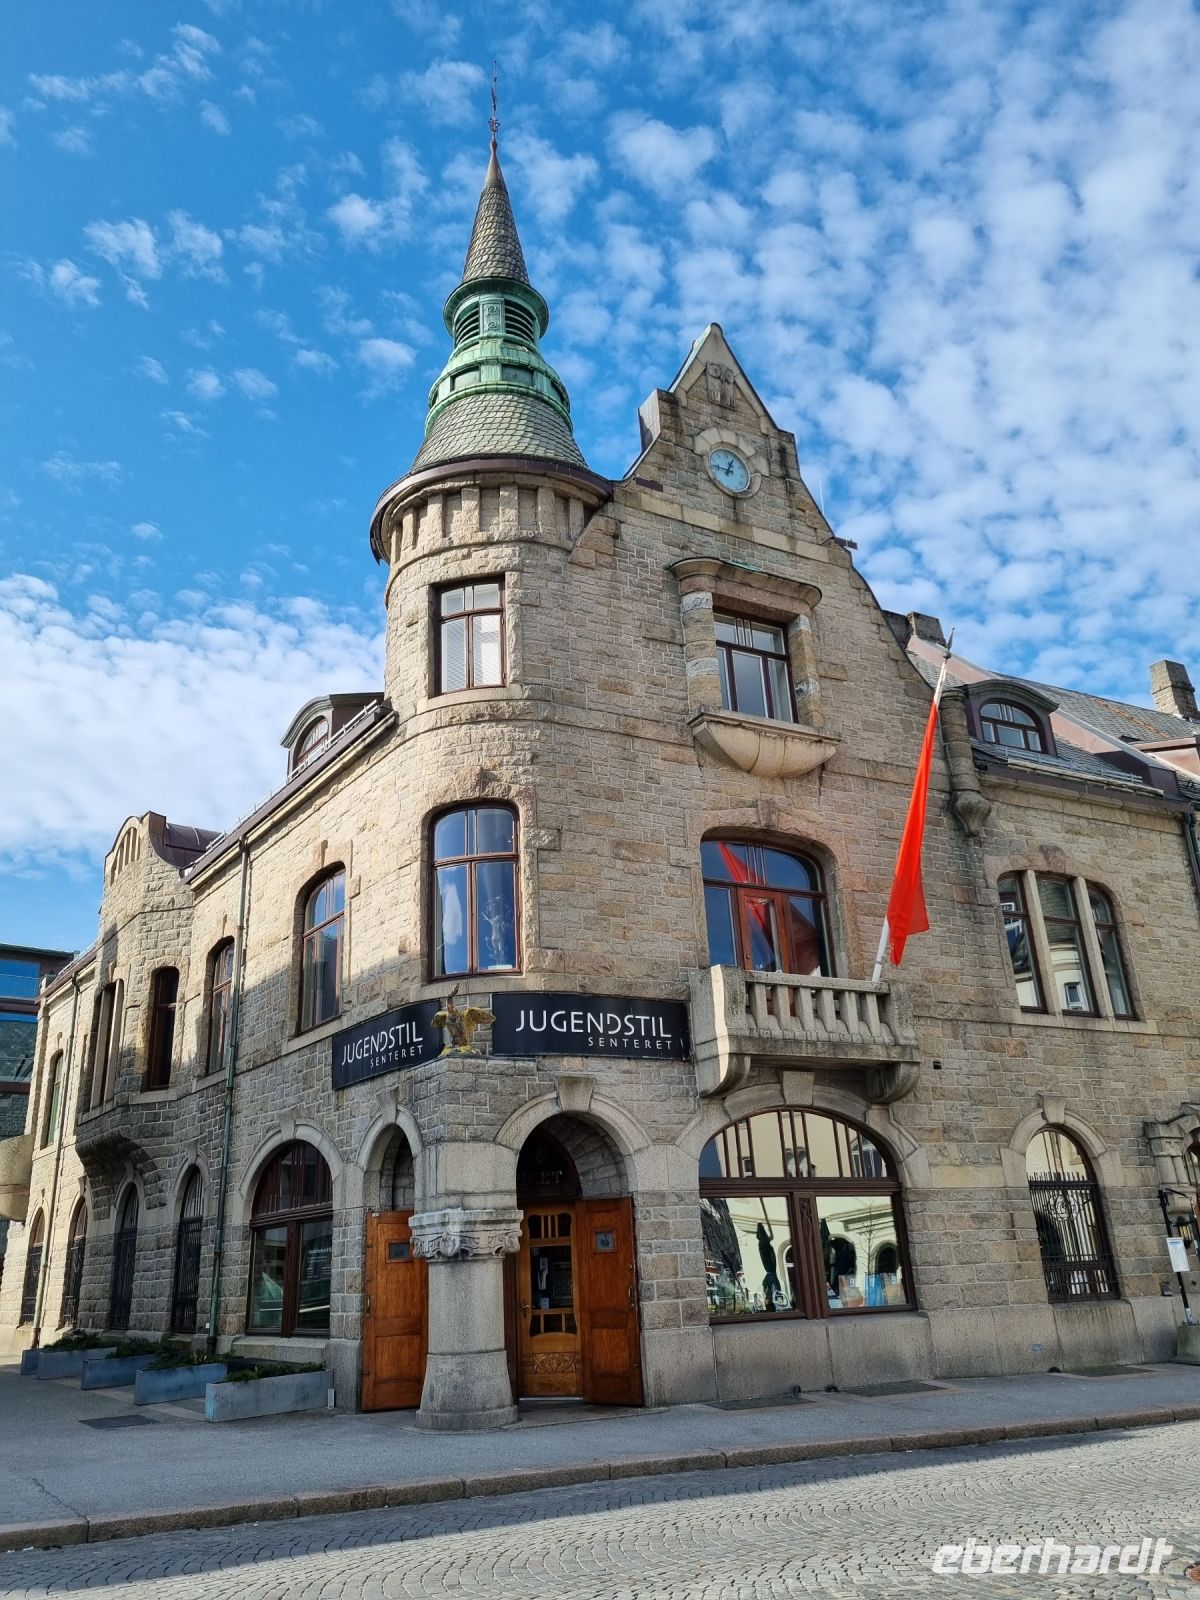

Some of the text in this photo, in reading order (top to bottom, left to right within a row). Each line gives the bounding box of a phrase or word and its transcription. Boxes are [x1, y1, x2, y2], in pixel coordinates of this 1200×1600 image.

[515, 1010, 672, 1038] JUGENDSTIL
[341, 1021, 424, 1066] JUGENDSTIL
[369, 1044, 424, 1068] SENTERET
[587, 1036, 673, 1050] SENTERET
